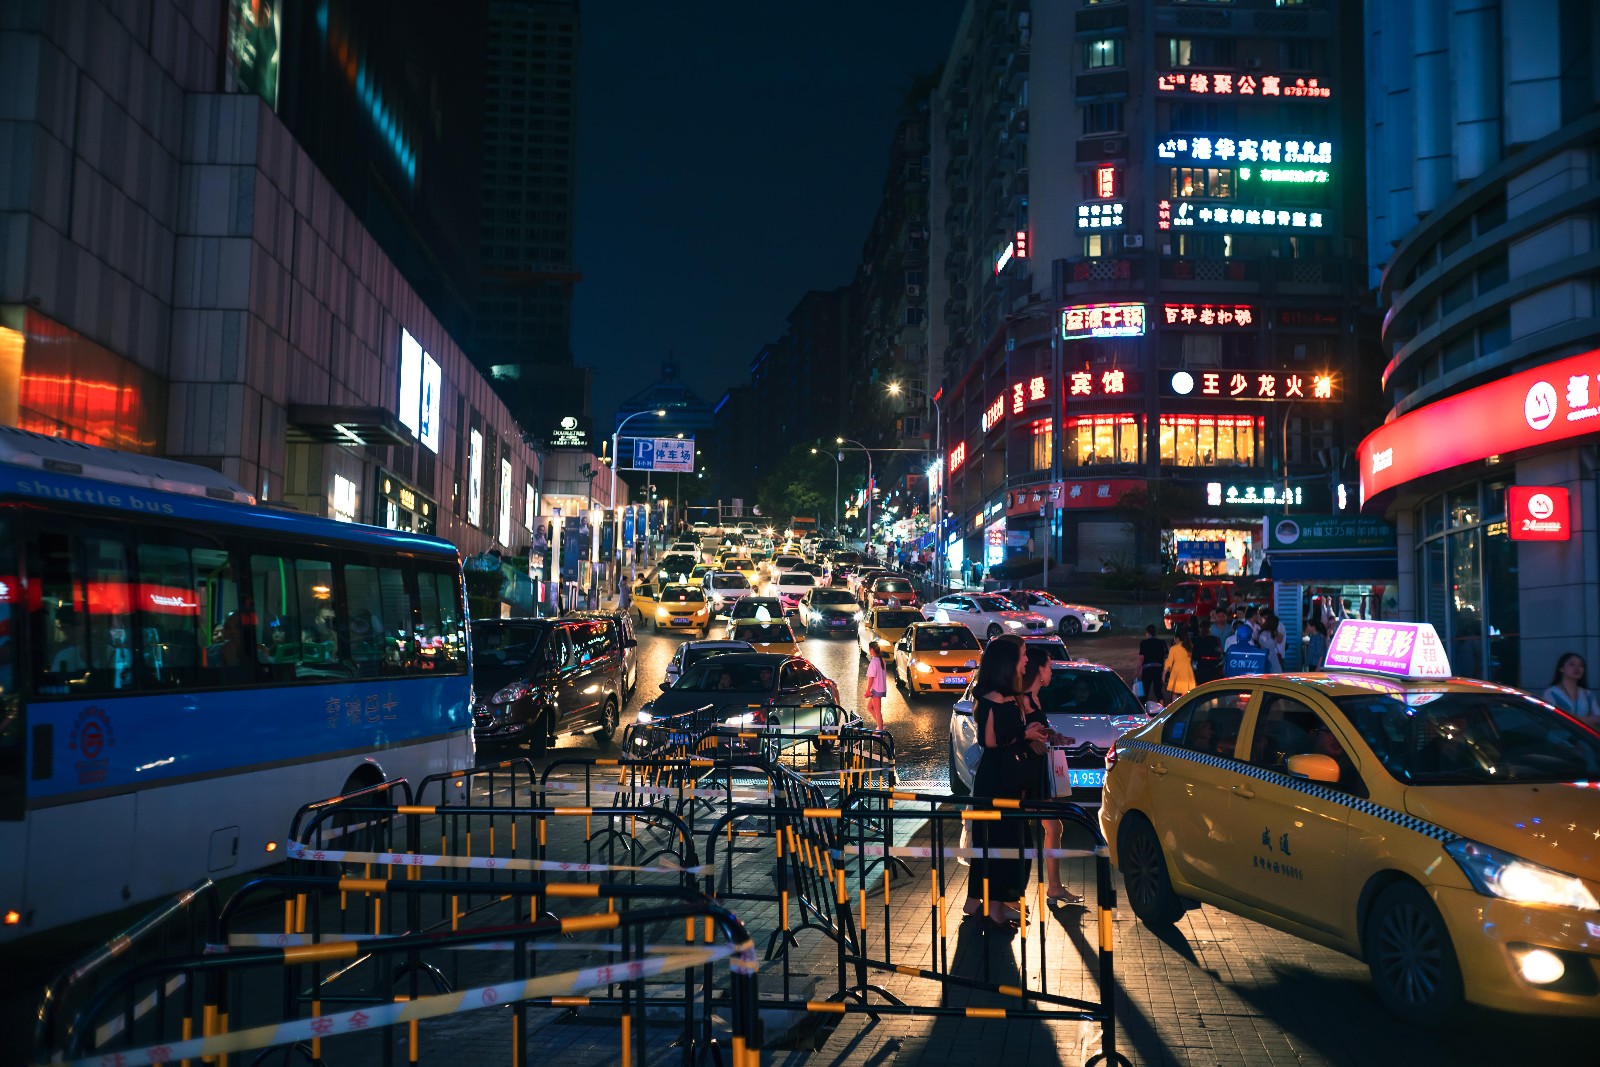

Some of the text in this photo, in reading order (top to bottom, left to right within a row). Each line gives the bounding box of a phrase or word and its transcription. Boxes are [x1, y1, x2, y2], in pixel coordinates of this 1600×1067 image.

[1189, 73, 1281, 96] 缘聚公寓
[1192, 138, 1282, 162] 港华宾馆
[1012, 370, 1125, 414] 圣堡宾馆
[1203, 373, 1332, 399] 王少龙火锅
[637, 441, 654, 458] P
[656, 450, 691, 461] 停车场
[15, 480, 174, 514] shuttle bus
[1421, 631, 1438, 662] 出租
[1417, 664, 1445, 675] TAXI
[310, 1011, 370, 1035] 安全
